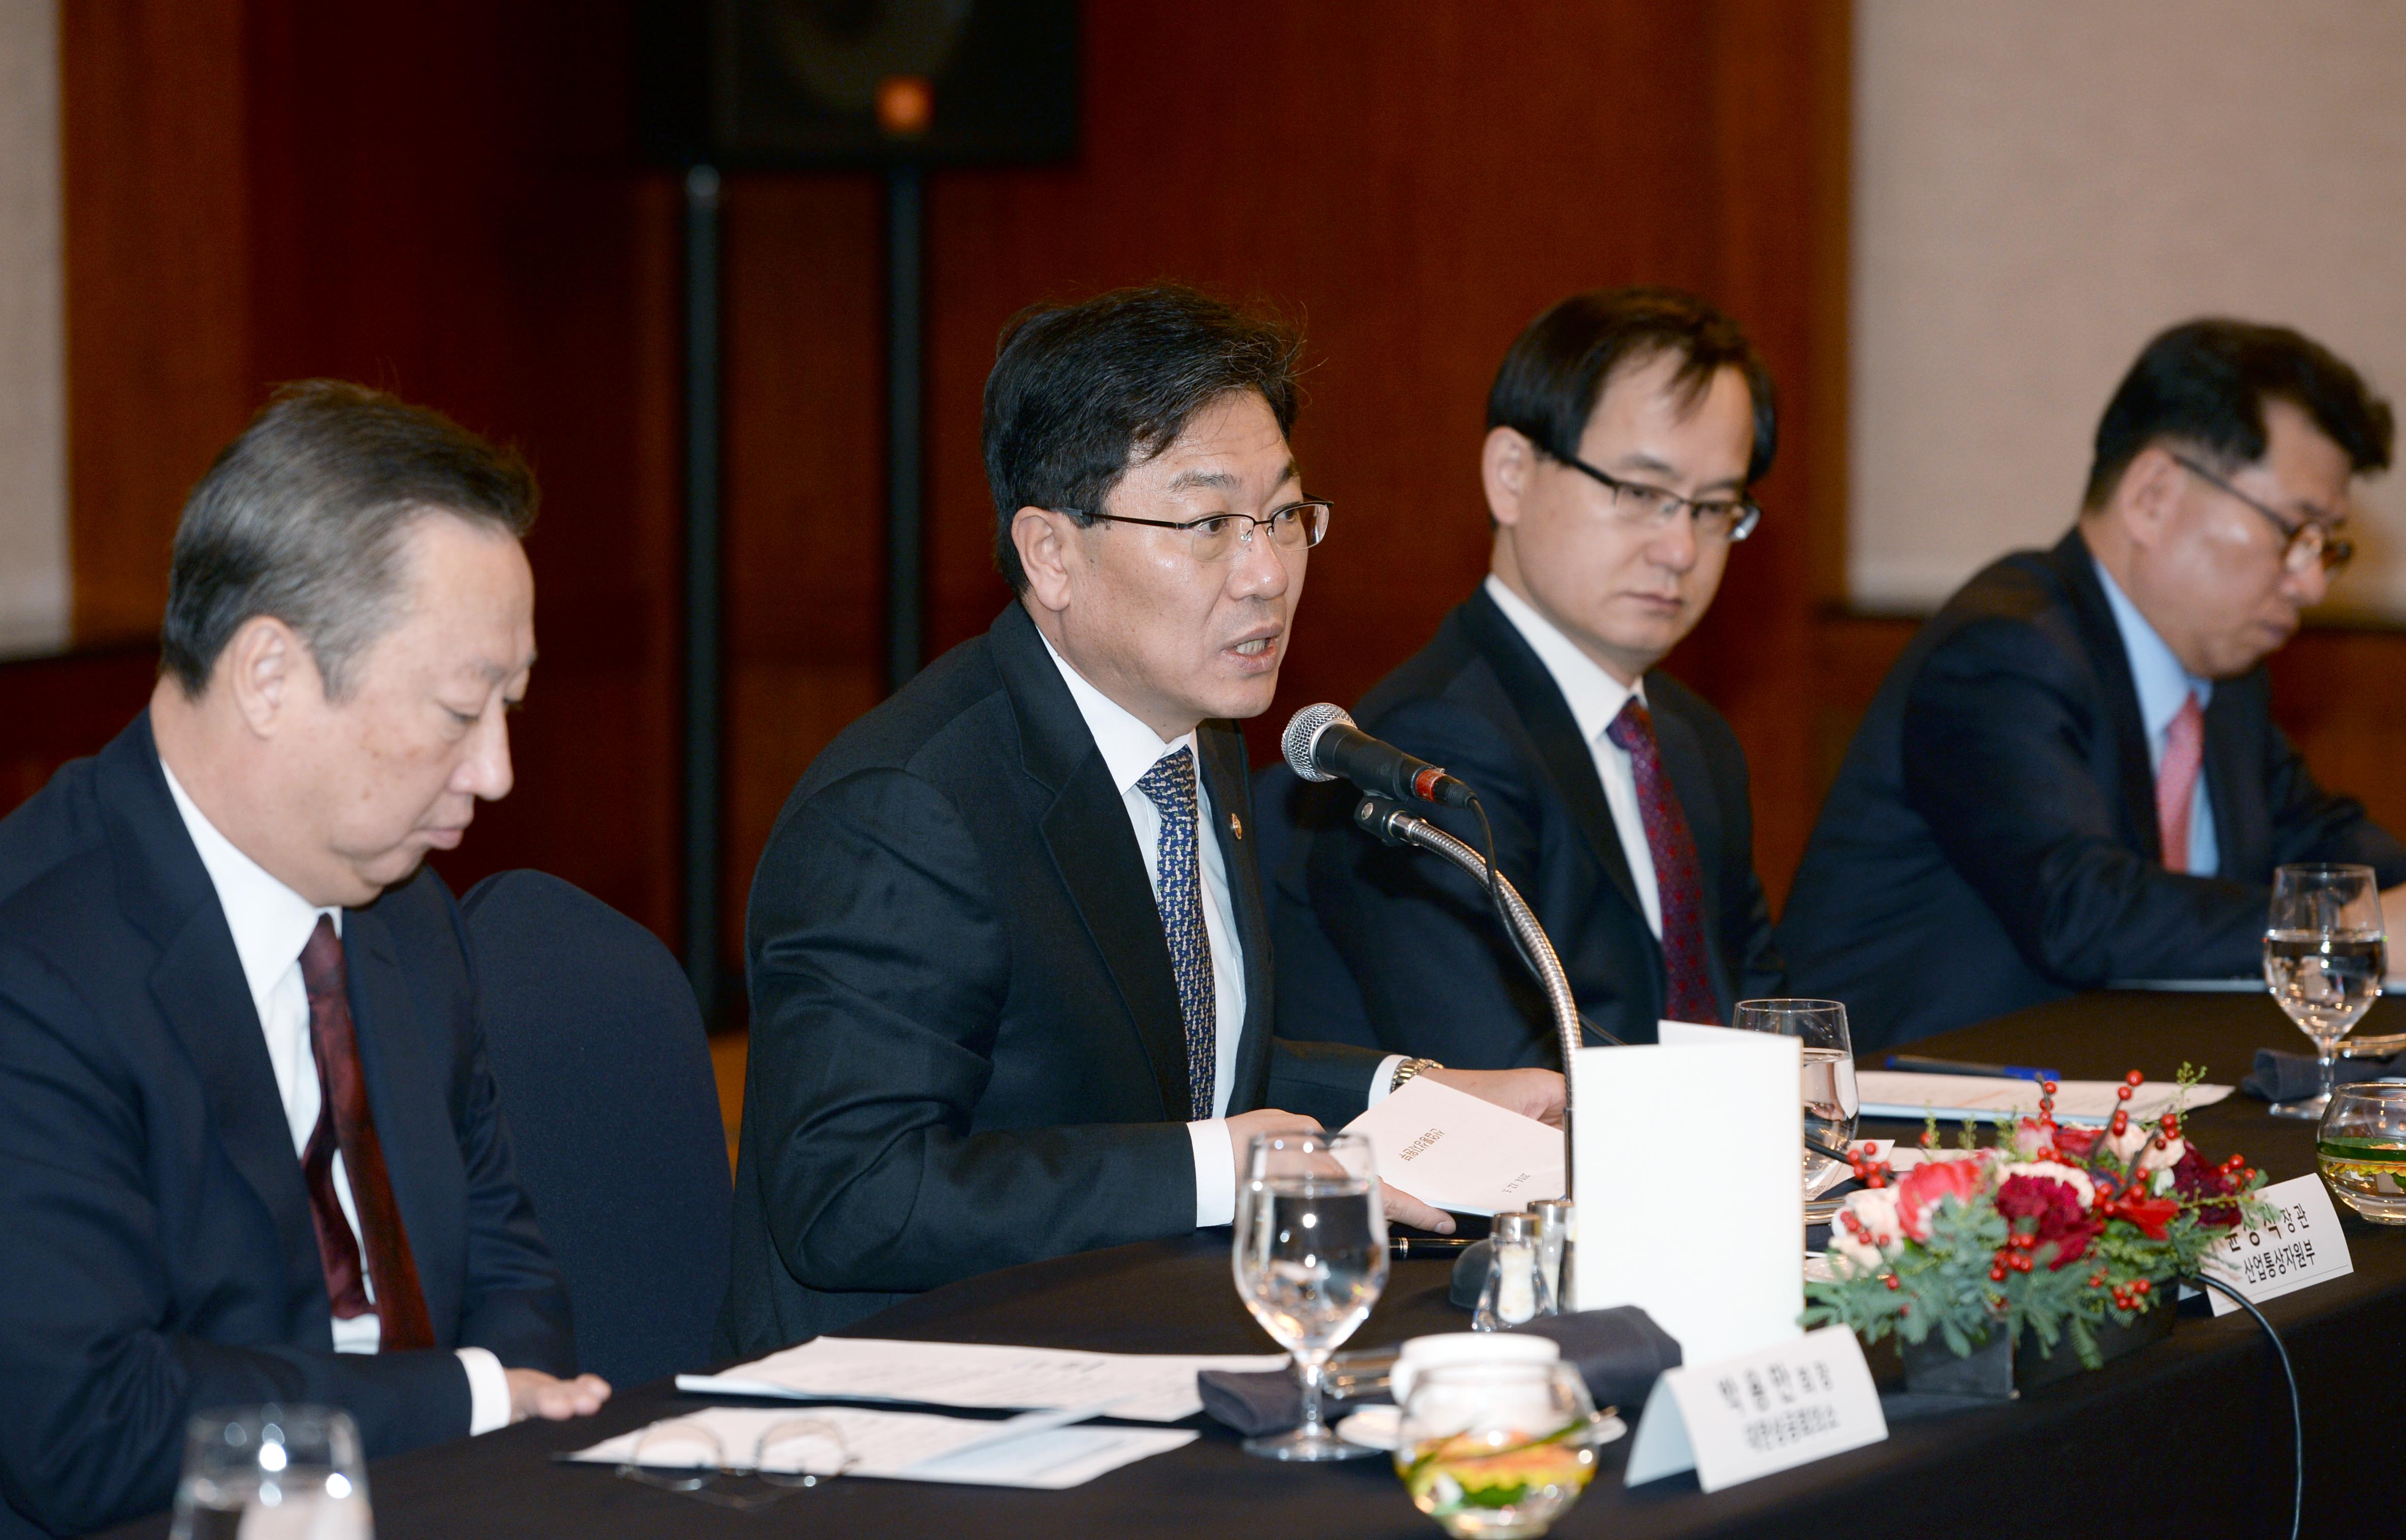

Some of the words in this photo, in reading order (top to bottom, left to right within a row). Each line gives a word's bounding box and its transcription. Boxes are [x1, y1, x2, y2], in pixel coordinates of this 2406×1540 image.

[1399, 1128, 1445, 1161] 산업통상자원부
[2280, 1203, 2309, 1233] 장관
[2244, 1239, 2315, 1284] 산업통상자원부
